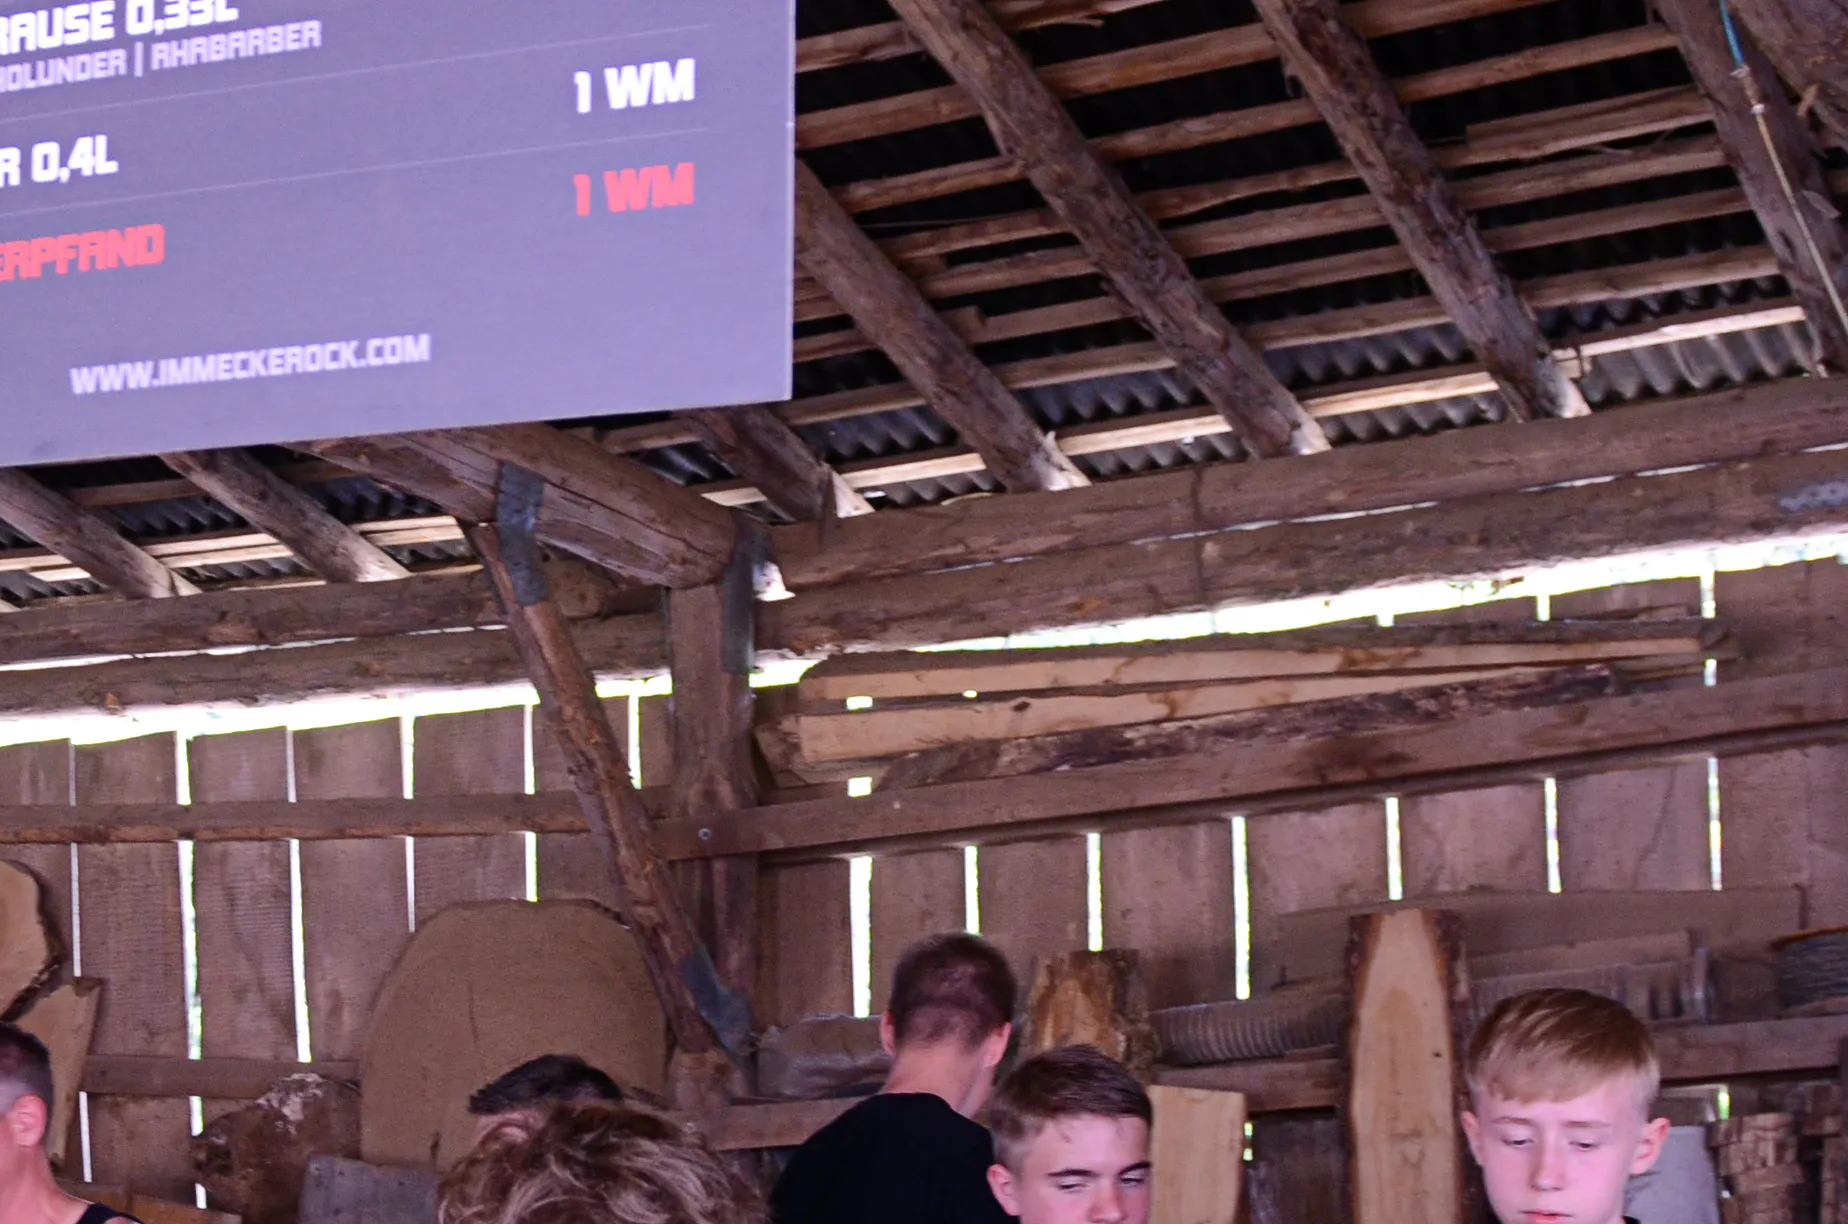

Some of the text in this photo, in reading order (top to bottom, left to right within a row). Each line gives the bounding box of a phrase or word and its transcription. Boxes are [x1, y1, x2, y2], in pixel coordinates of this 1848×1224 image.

[151, 19, 322, 71] RHABARBER
[573, 58, 695, 114] 1 WM
[31, 134, 119, 184] 0,4L
[573, 162, 695, 217] 1 WM
[69, 333, 432, 395] WWW.IMMECKEROCK.COM
